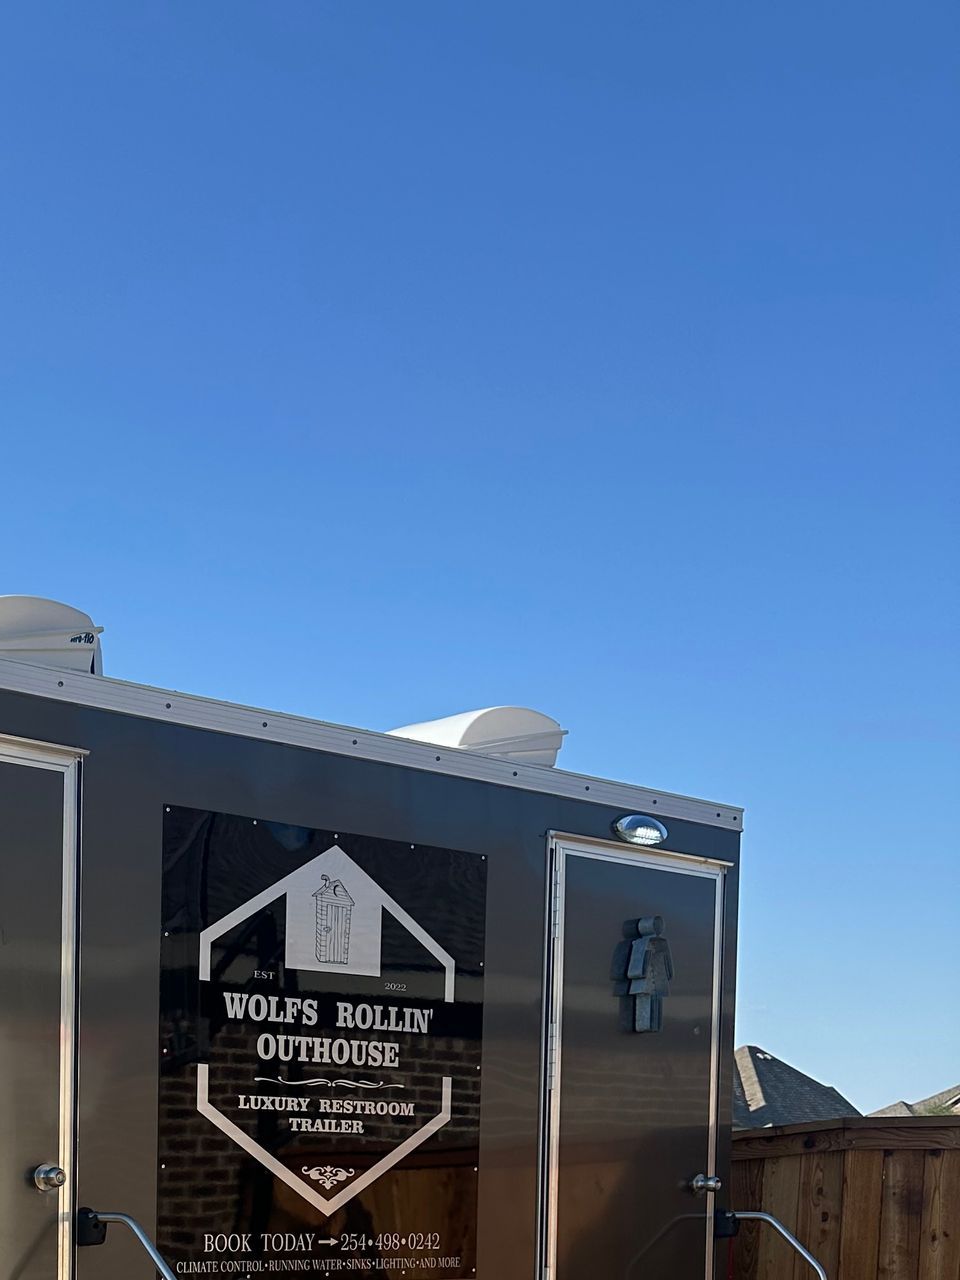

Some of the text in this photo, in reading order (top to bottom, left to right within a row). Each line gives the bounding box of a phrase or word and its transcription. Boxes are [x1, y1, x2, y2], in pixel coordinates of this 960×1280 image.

[253, 970, 275, 980] EST
[384, 982, 407, 992] 2022
[223, 992, 433, 1034] WOLFS ROLLIN'
[256, 1033, 399, 1068] OUTHOUSE
[238, 1095, 415, 1116] LUXURY RESTROOM
[289, 1118, 364, 1134] TRAILER
[203, 1233, 252, 1253] BOOK
[260, 1233, 315, 1252] TODAY
[176, 1256, 461, 1274] CLIMATE CONTROL RUNNING WATER SINKS LIGHTING AND MORE
